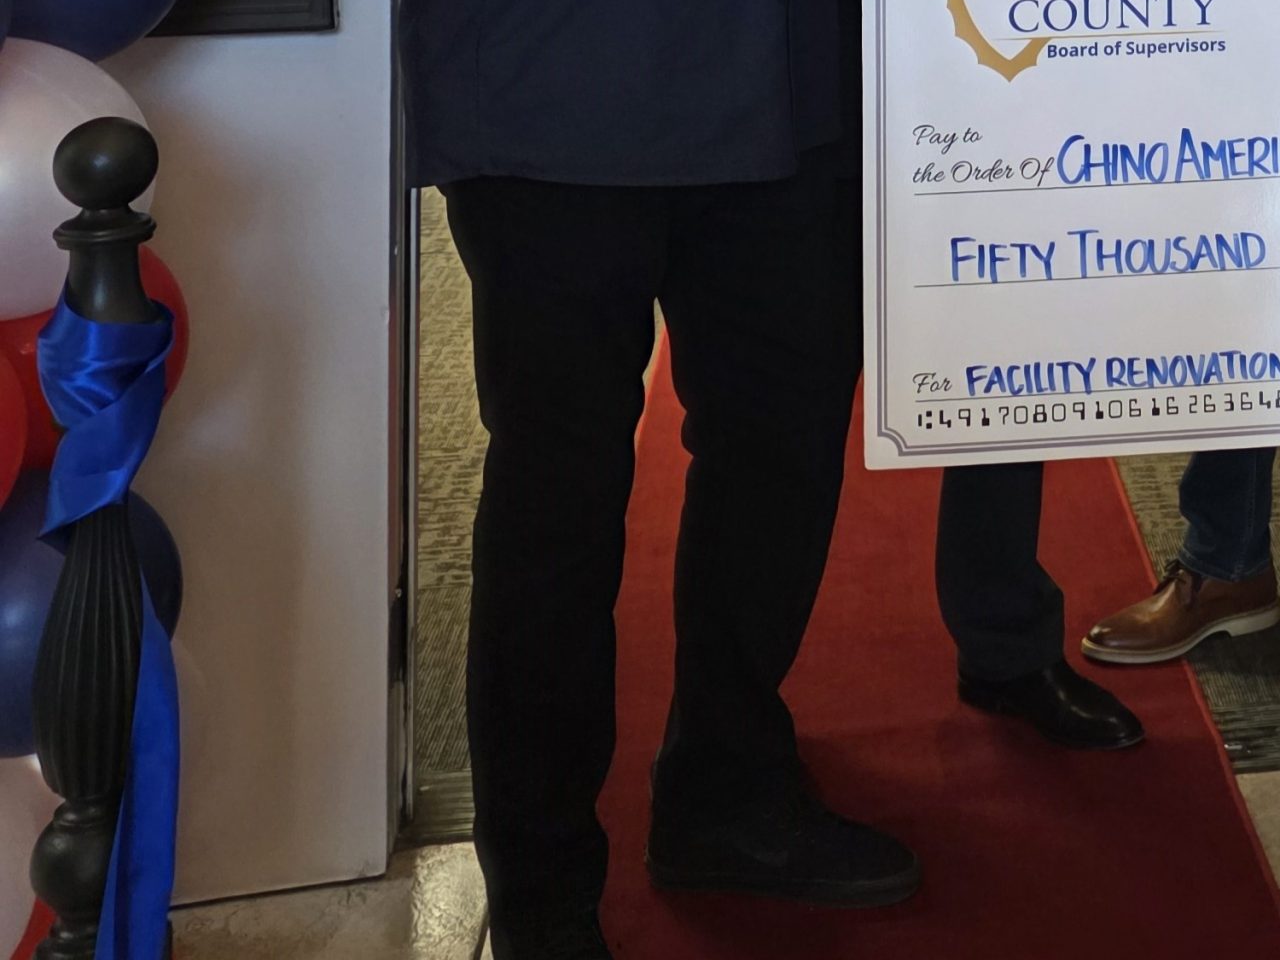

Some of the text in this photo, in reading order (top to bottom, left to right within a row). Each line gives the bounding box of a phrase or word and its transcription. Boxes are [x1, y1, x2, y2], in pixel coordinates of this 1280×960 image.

[1047, 38, 1226, 58] Board of Supervisors
[912, 124, 983, 155] Pay to
[912, 156, 1055, 188] the Order Of
[1056, 134, 1169, 186] CHINO
[950, 236, 1056, 284] FIFTY
[1066, 229, 1266, 279] THOUSAND
[912, 372, 953, 394] For
[965, 357, 1097, 397] FACILITY
